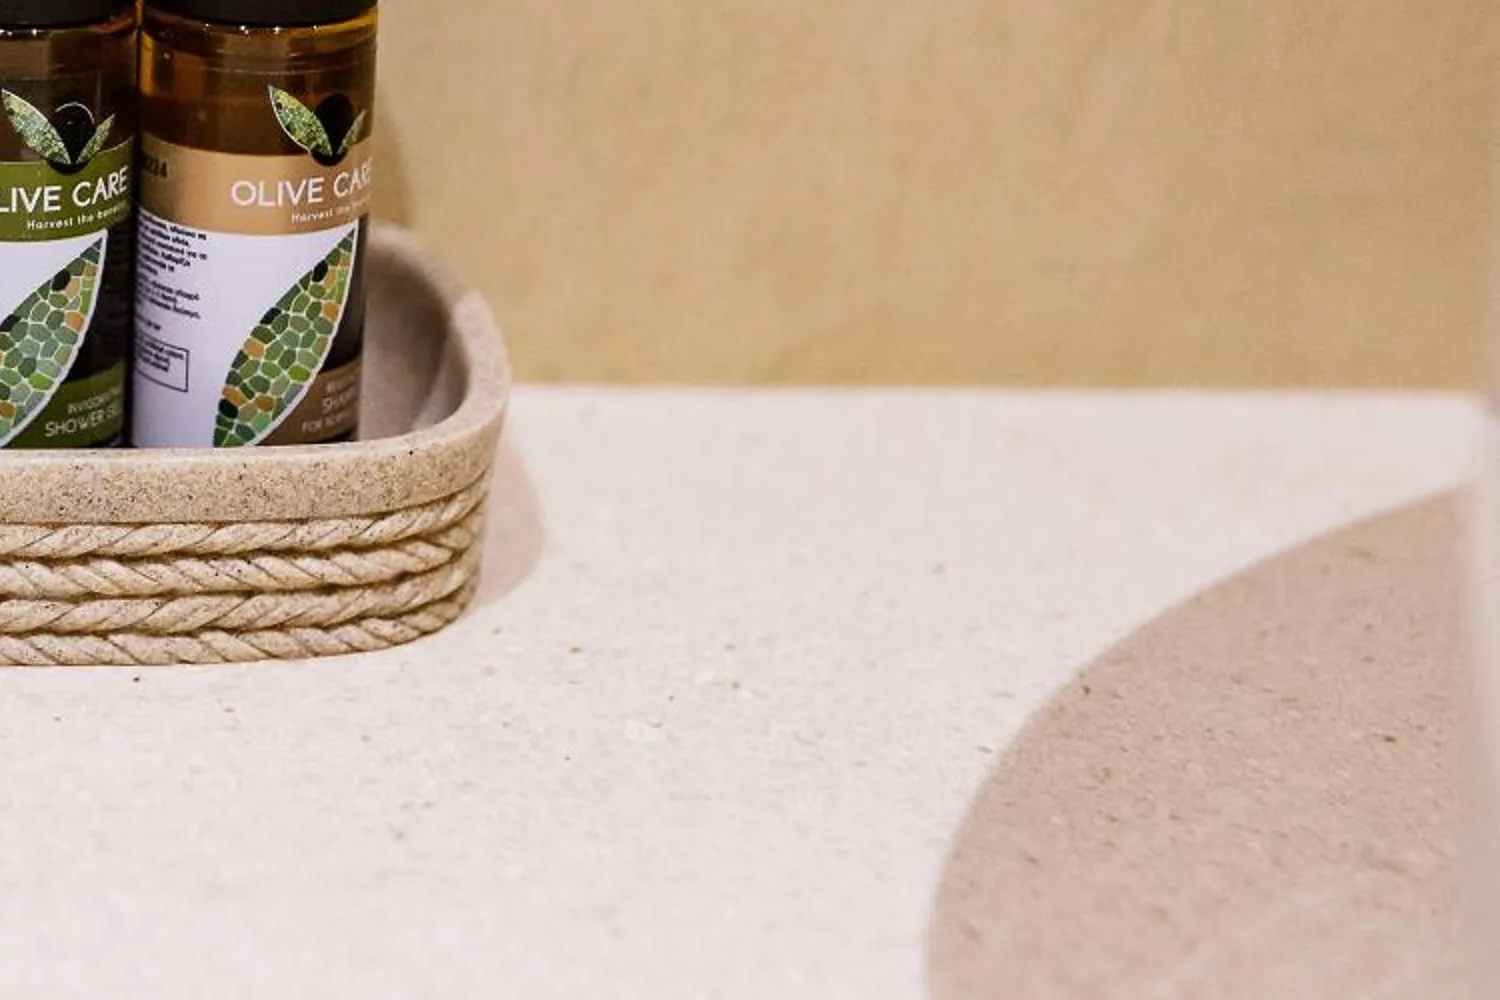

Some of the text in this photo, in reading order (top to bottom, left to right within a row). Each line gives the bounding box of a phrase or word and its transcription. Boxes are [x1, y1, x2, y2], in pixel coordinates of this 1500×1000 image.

[71, 165, 129, 208] CARE
[231, 177, 325, 208] OLIVE
[26, 212, 94, 232] Harvest the
